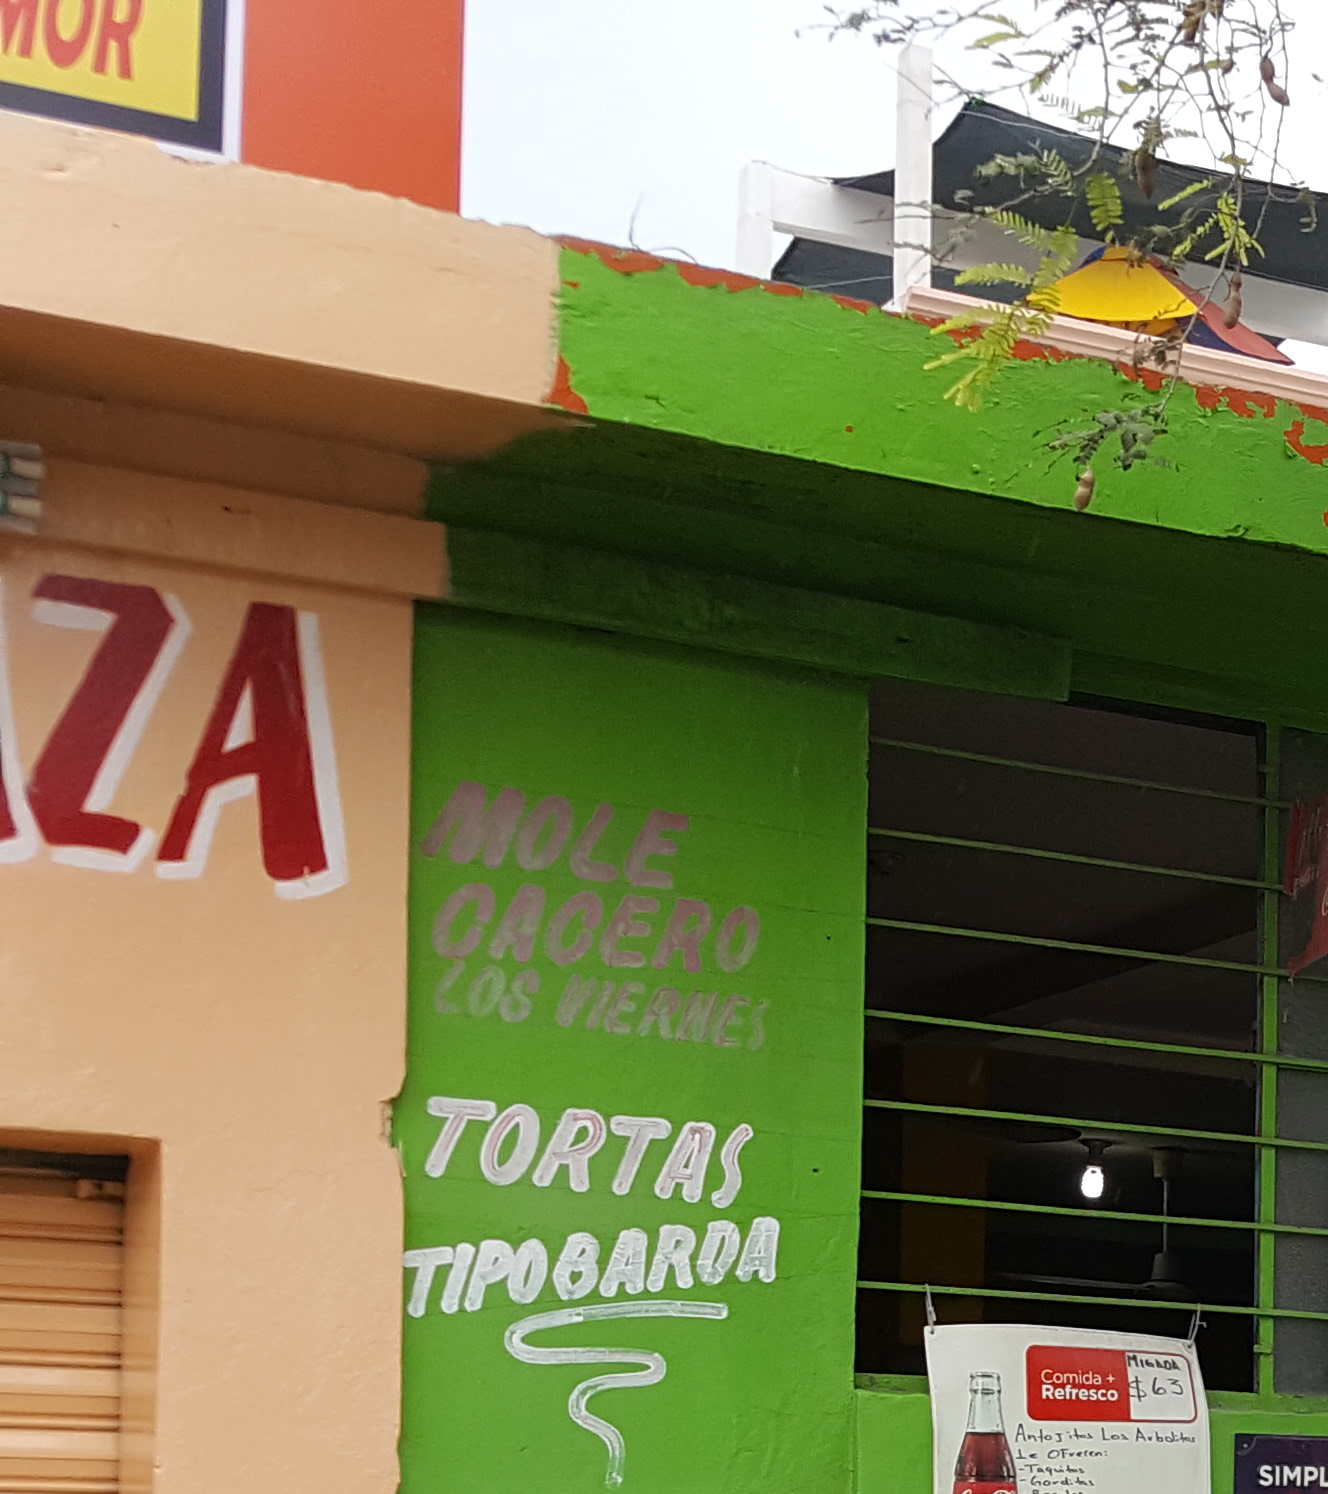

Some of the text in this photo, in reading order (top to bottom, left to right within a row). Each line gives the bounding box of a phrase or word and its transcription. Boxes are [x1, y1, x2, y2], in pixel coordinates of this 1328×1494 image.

[0, 574, 347, 899] ZA
[421, 780, 690, 888] MOLE
[431, 882, 761, 974] CACERO
[435, 960, 769, 1050] LOS VIERNES
[424, 1096, 754, 1208] TORTAS
[1041, 1369, 1102, 1386] Comida
[1041, 1385, 1119, 1402] Refresco
[1101, 1427, 1129, 1442] Los
